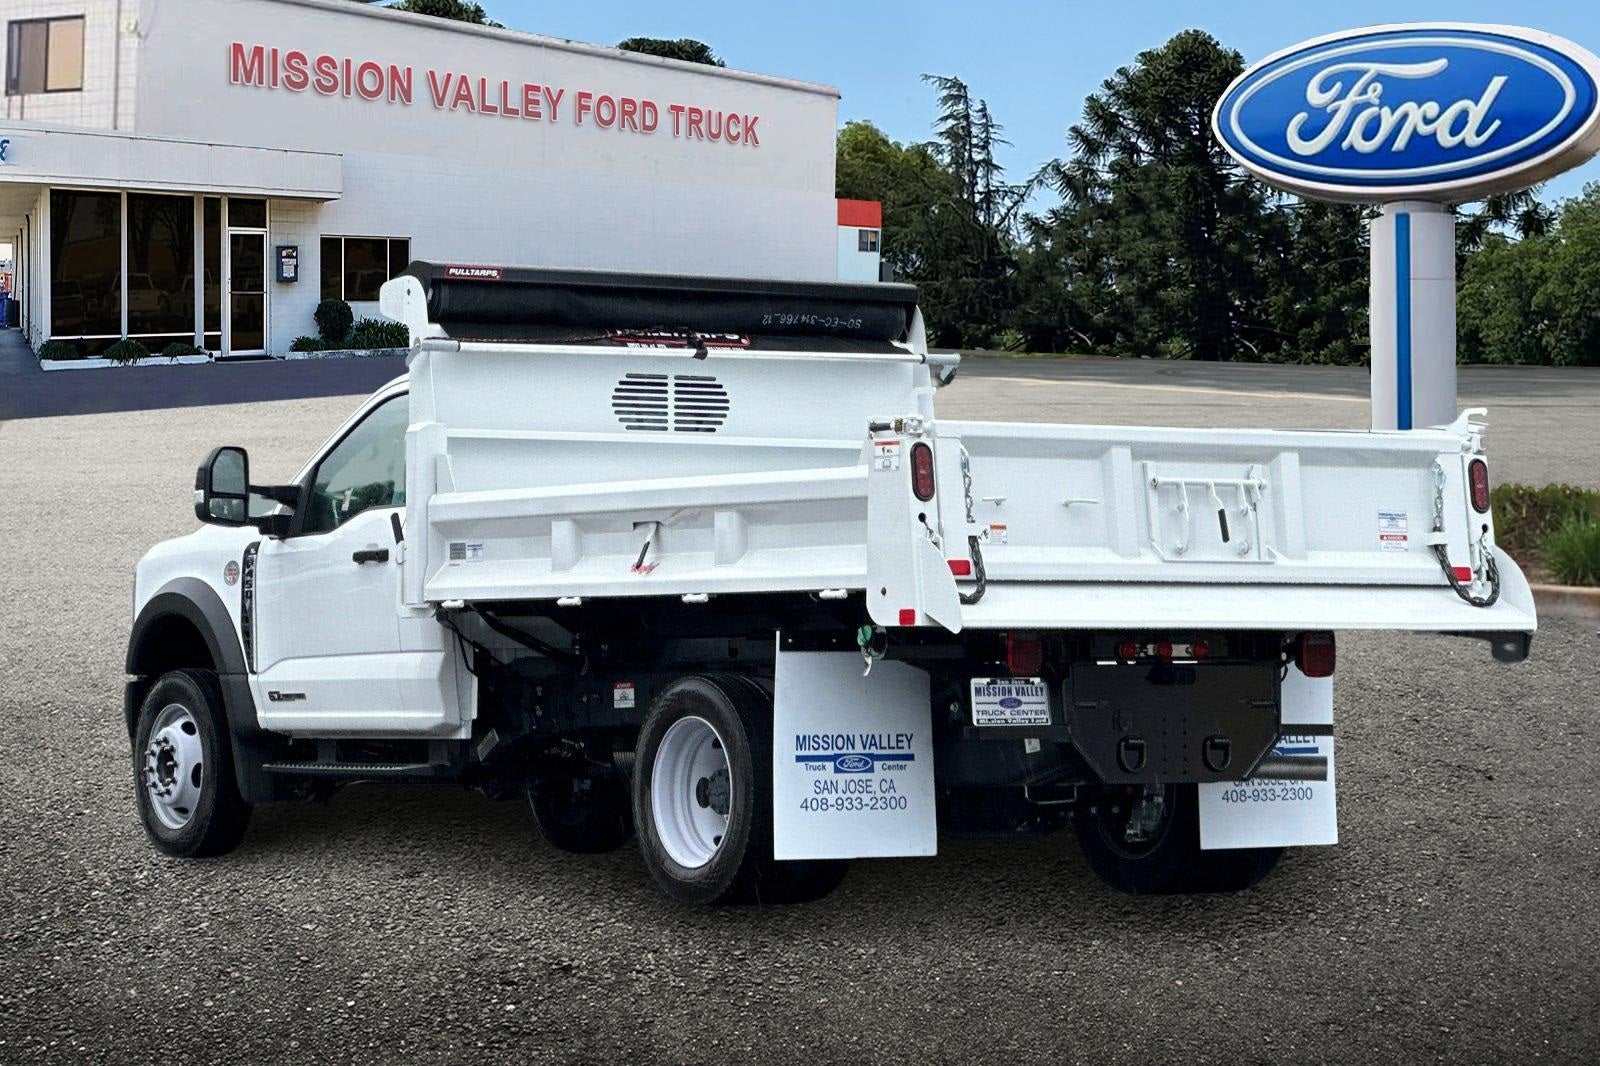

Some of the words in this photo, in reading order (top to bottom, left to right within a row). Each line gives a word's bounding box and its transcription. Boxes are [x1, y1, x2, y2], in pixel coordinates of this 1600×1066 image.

[230, 42, 412, 104] MISSION
[427, 68, 565, 121] VALLEY
[575, 91, 659, 133] FORD
[669, 103, 760, 146] TRUCK
[1286, 58, 1508, 156] Ford
[448, 268, 498, 277] PULLTARPS
[974, 686, 1012, 697] MISSION
[1015, 686, 1044, 697] VALLEY
[795, 734, 855, 751] MISSION
[860, 733, 914, 750] VALLEY
[805, 763, 827, 771] Truck
[843, 757, 865, 768] Ford
[881, 762, 908, 771] Center
[814, 780, 838, 794] SAN
[842, 779, 876, 796] JOSE,
[879, 779, 896, 793] CA
[1221, 787, 1313, 803] 408-933-2300
[800, 796, 907, 811] 408-933-2300
